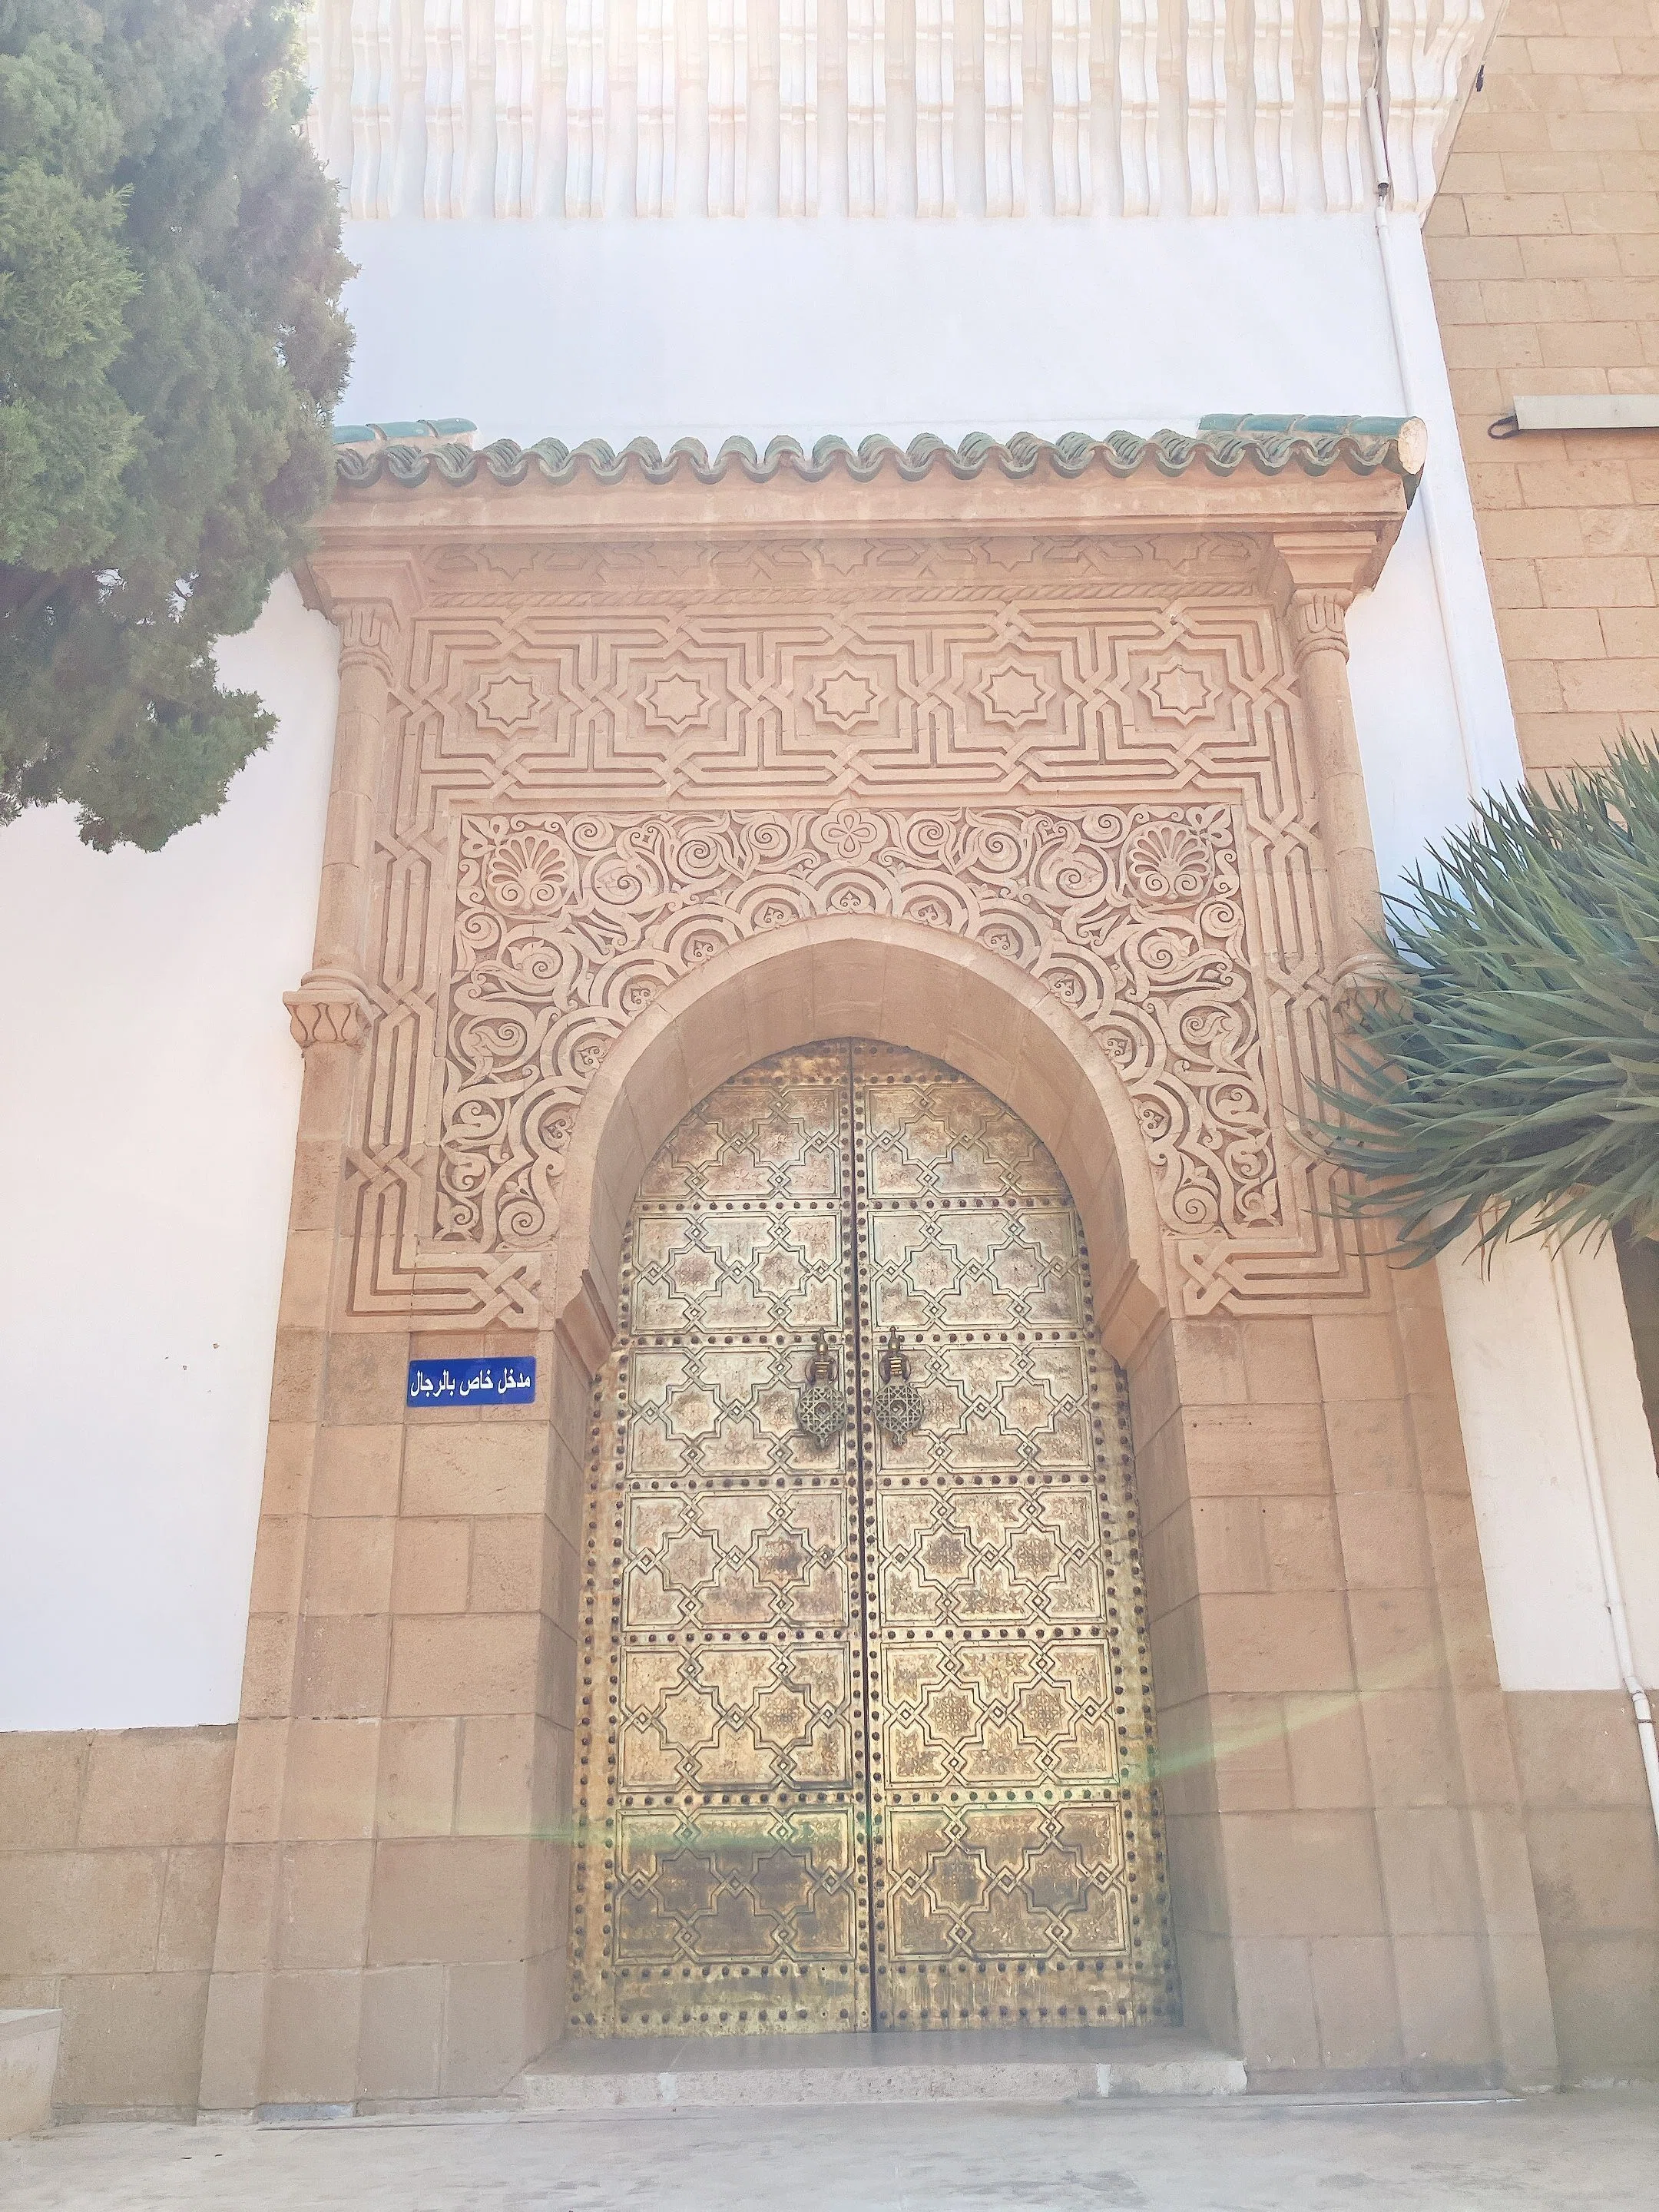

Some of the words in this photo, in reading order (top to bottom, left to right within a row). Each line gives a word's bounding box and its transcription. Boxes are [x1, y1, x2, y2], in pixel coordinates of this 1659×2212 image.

[410, 1369, 455, 1398] بالرجال
[459, 1369, 494, 1396] خاص
[497, 1366, 531, 1394] مدخل
